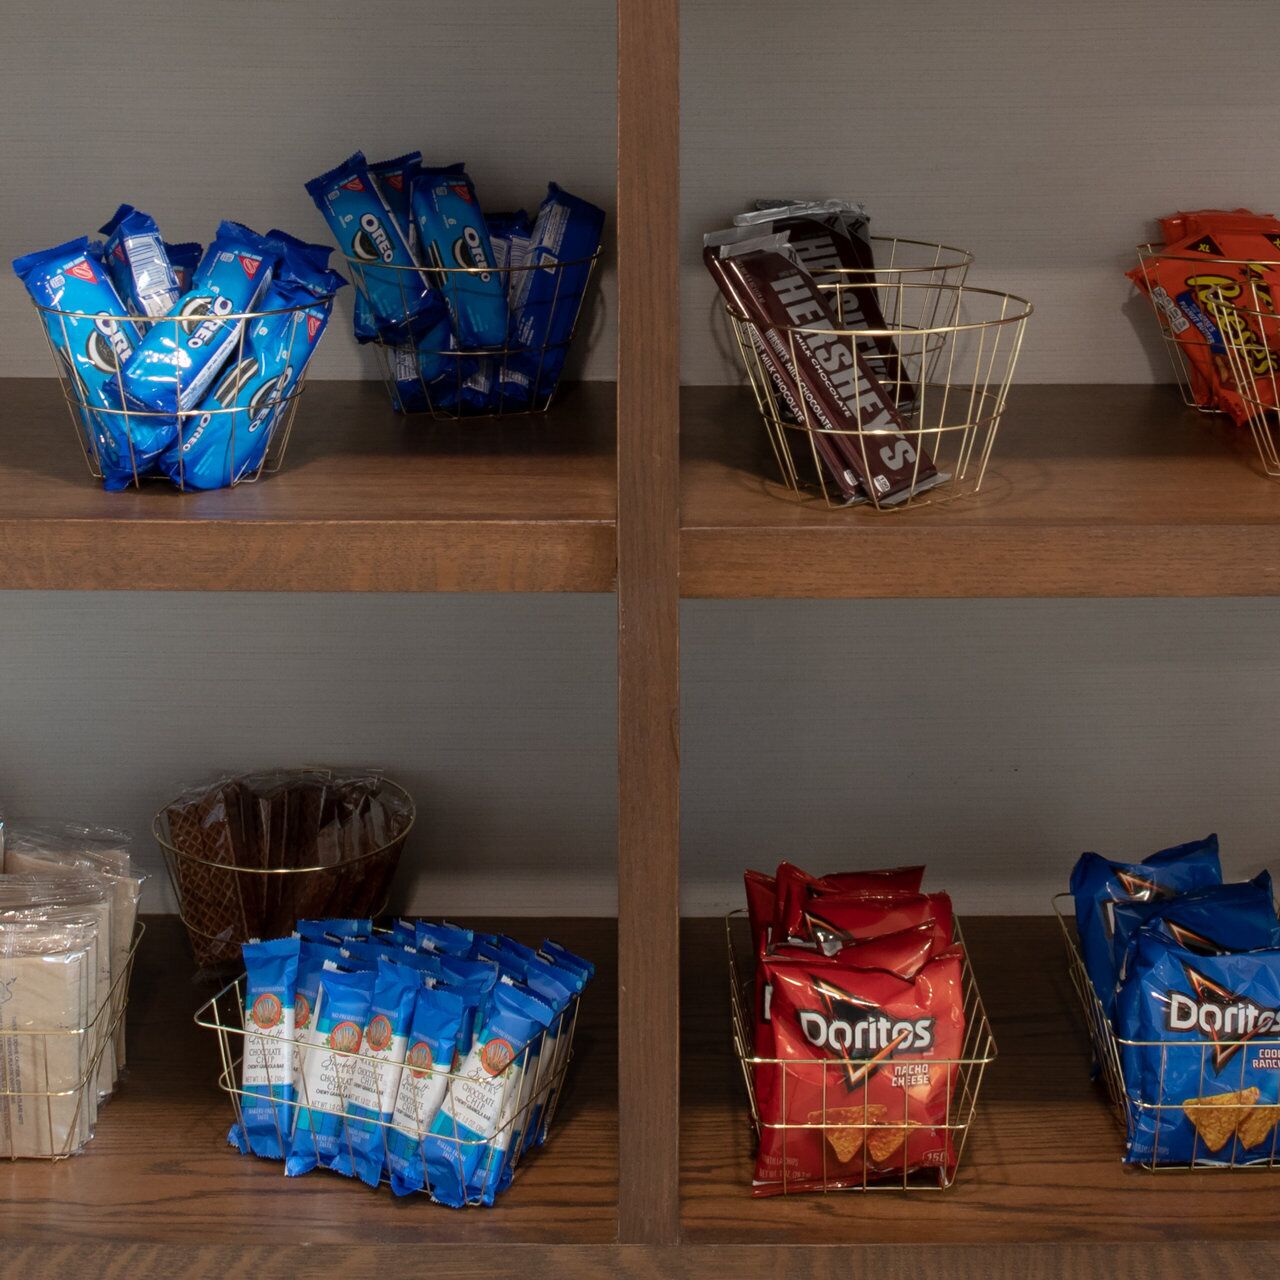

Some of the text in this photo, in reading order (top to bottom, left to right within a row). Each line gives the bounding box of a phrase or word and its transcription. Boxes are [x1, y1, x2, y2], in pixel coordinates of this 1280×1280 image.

[360, 213, 394, 264] OREO
[463, 226, 492, 283] OREO
[1197, 243, 1211, 253] XL
[187, 295, 234, 350] OREO
[1186, 275, 1280, 375] Reese's
[761, 351, 804, 424] MILK CHOCOLATE
[771, 274, 917, 471] HERSHEY'S
[794, 333, 853, 419] MILK CHOCOLATE
[796, 379, 833, 431] CHOCOLATE
[182, 412, 212, 452] OREO
[800, 1010, 933, 1052] Doritos
[248, 1048, 282, 1057] CHOCOLATE
[255, 1056, 276, 1064] CHIP
[894, 1064, 930, 1076] NACHO
[320, 1074, 352, 1086] CHOCOLAT
[462, 1082, 495, 1108] CHOCOLATE
[892, 1074, 931, 1088] CHEESE
[465, 1095, 486, 1111] CHIP
